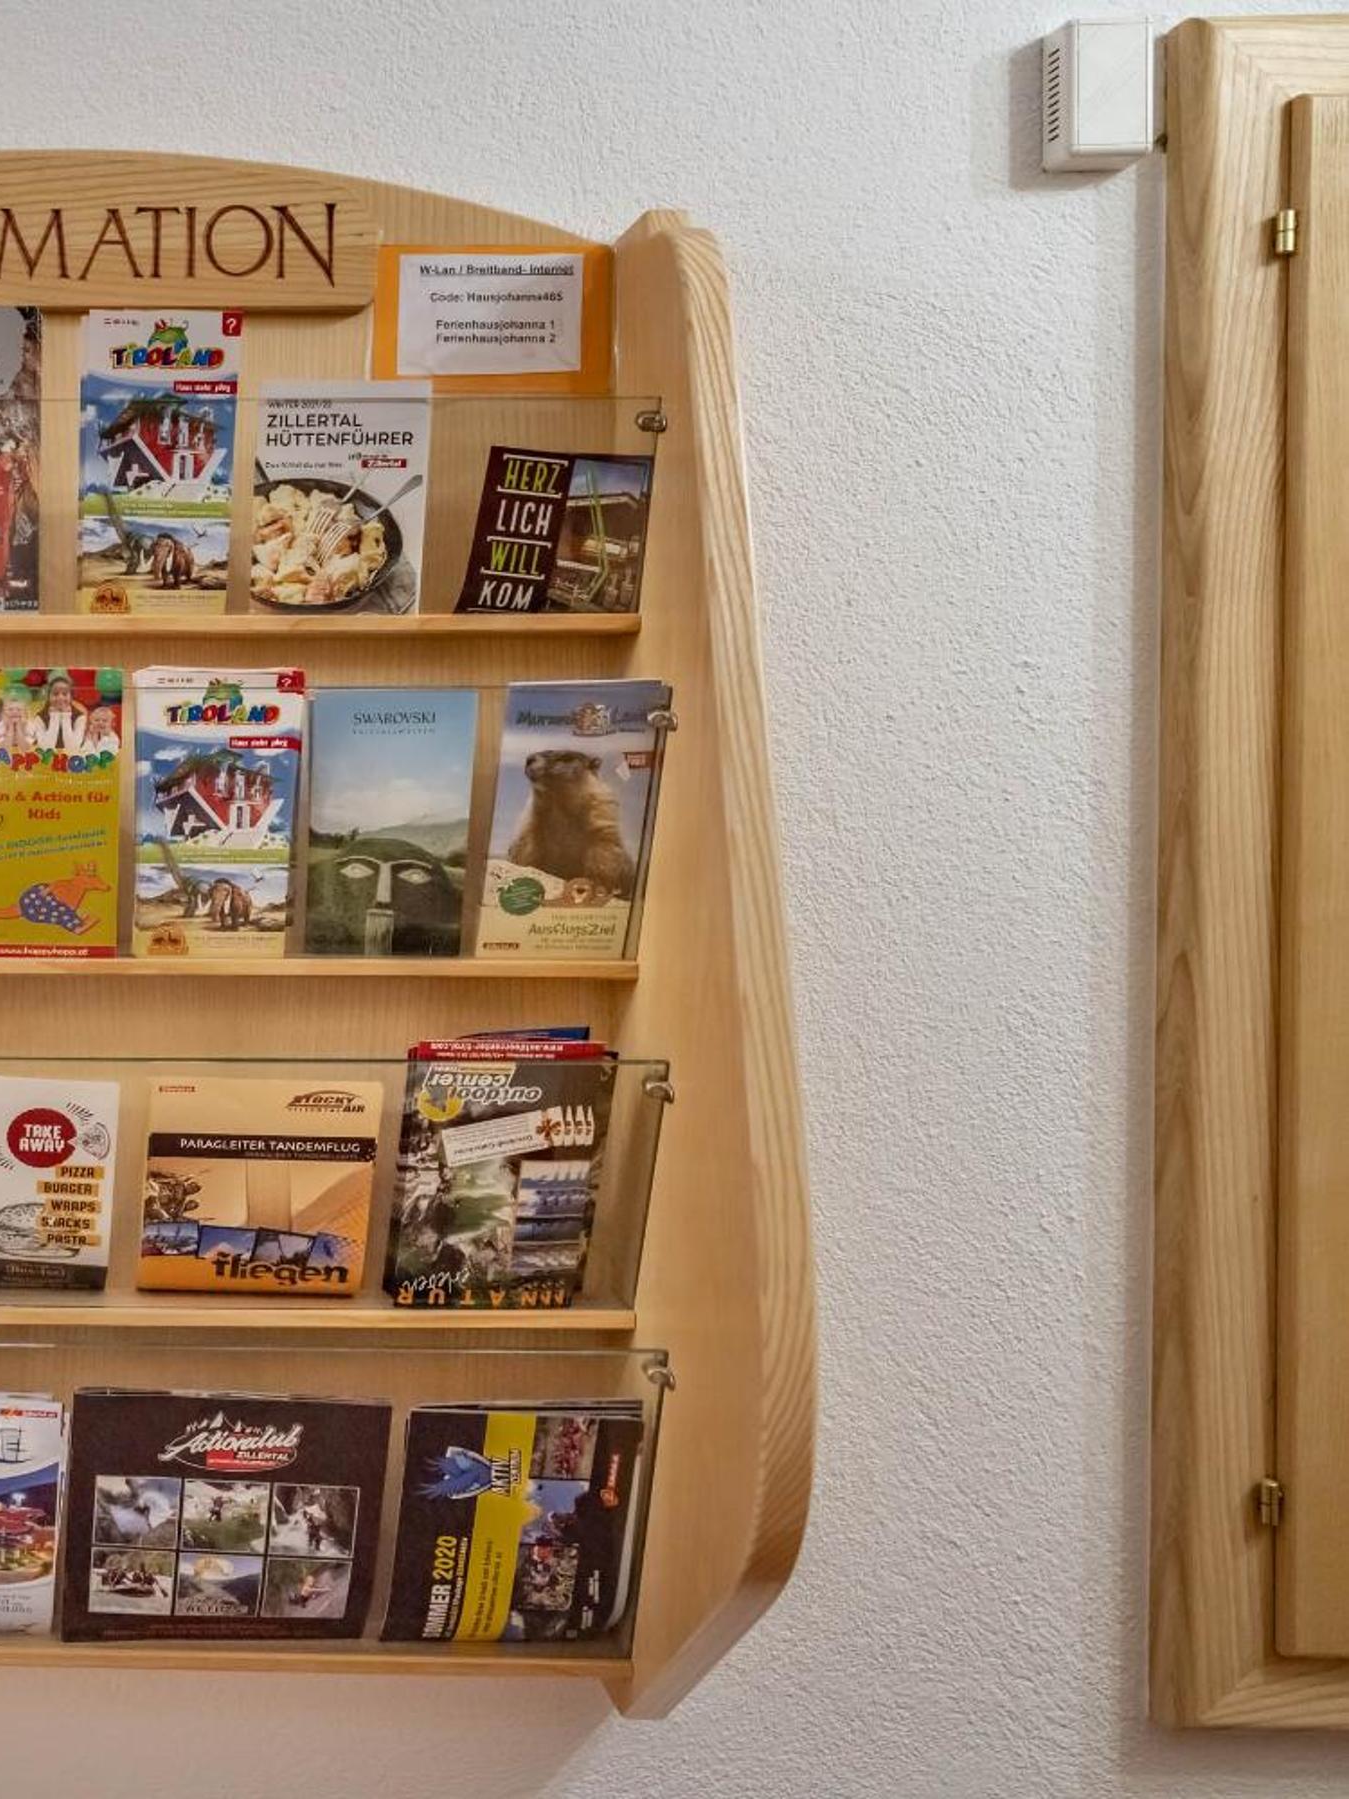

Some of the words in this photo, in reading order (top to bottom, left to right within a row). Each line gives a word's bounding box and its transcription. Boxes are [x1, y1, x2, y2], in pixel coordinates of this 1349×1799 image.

[419, 264, 456, 276] W-Lan
[267, 413, 363, 428] ZILLERTAL
[265, 428, 414, 447] HÜTTENFÜHRER
[504, 458, 562, 494] HERZ
[496, 499, 553, 536] LICH
[490, 541, 542, 576] WILL
[478, 580, 534, 611] KOM
[353, 711, 437, 725] SWAROVSKI
[14, 790, 27, 803] &
[31, 790, 83, 803] Action
[26, 807, 62, 820] Kids
[24, 1124, 63, 1139] TAKE
[19, 1138, 65, 1152] AWAY
[179, 1137, 266, 1151] PARAGLEITER
[269, 1139, 361, 1153] TANDEMFLUG
[60, 1166, 95, 1178] PIZZA
[43, 1181, 92, 1195] BURGER
[50, 1200, 96, 1213] WRAPS
[211, 1250, 349, 1286] fliegen
[432, 1535, 457, 1580] 2020
